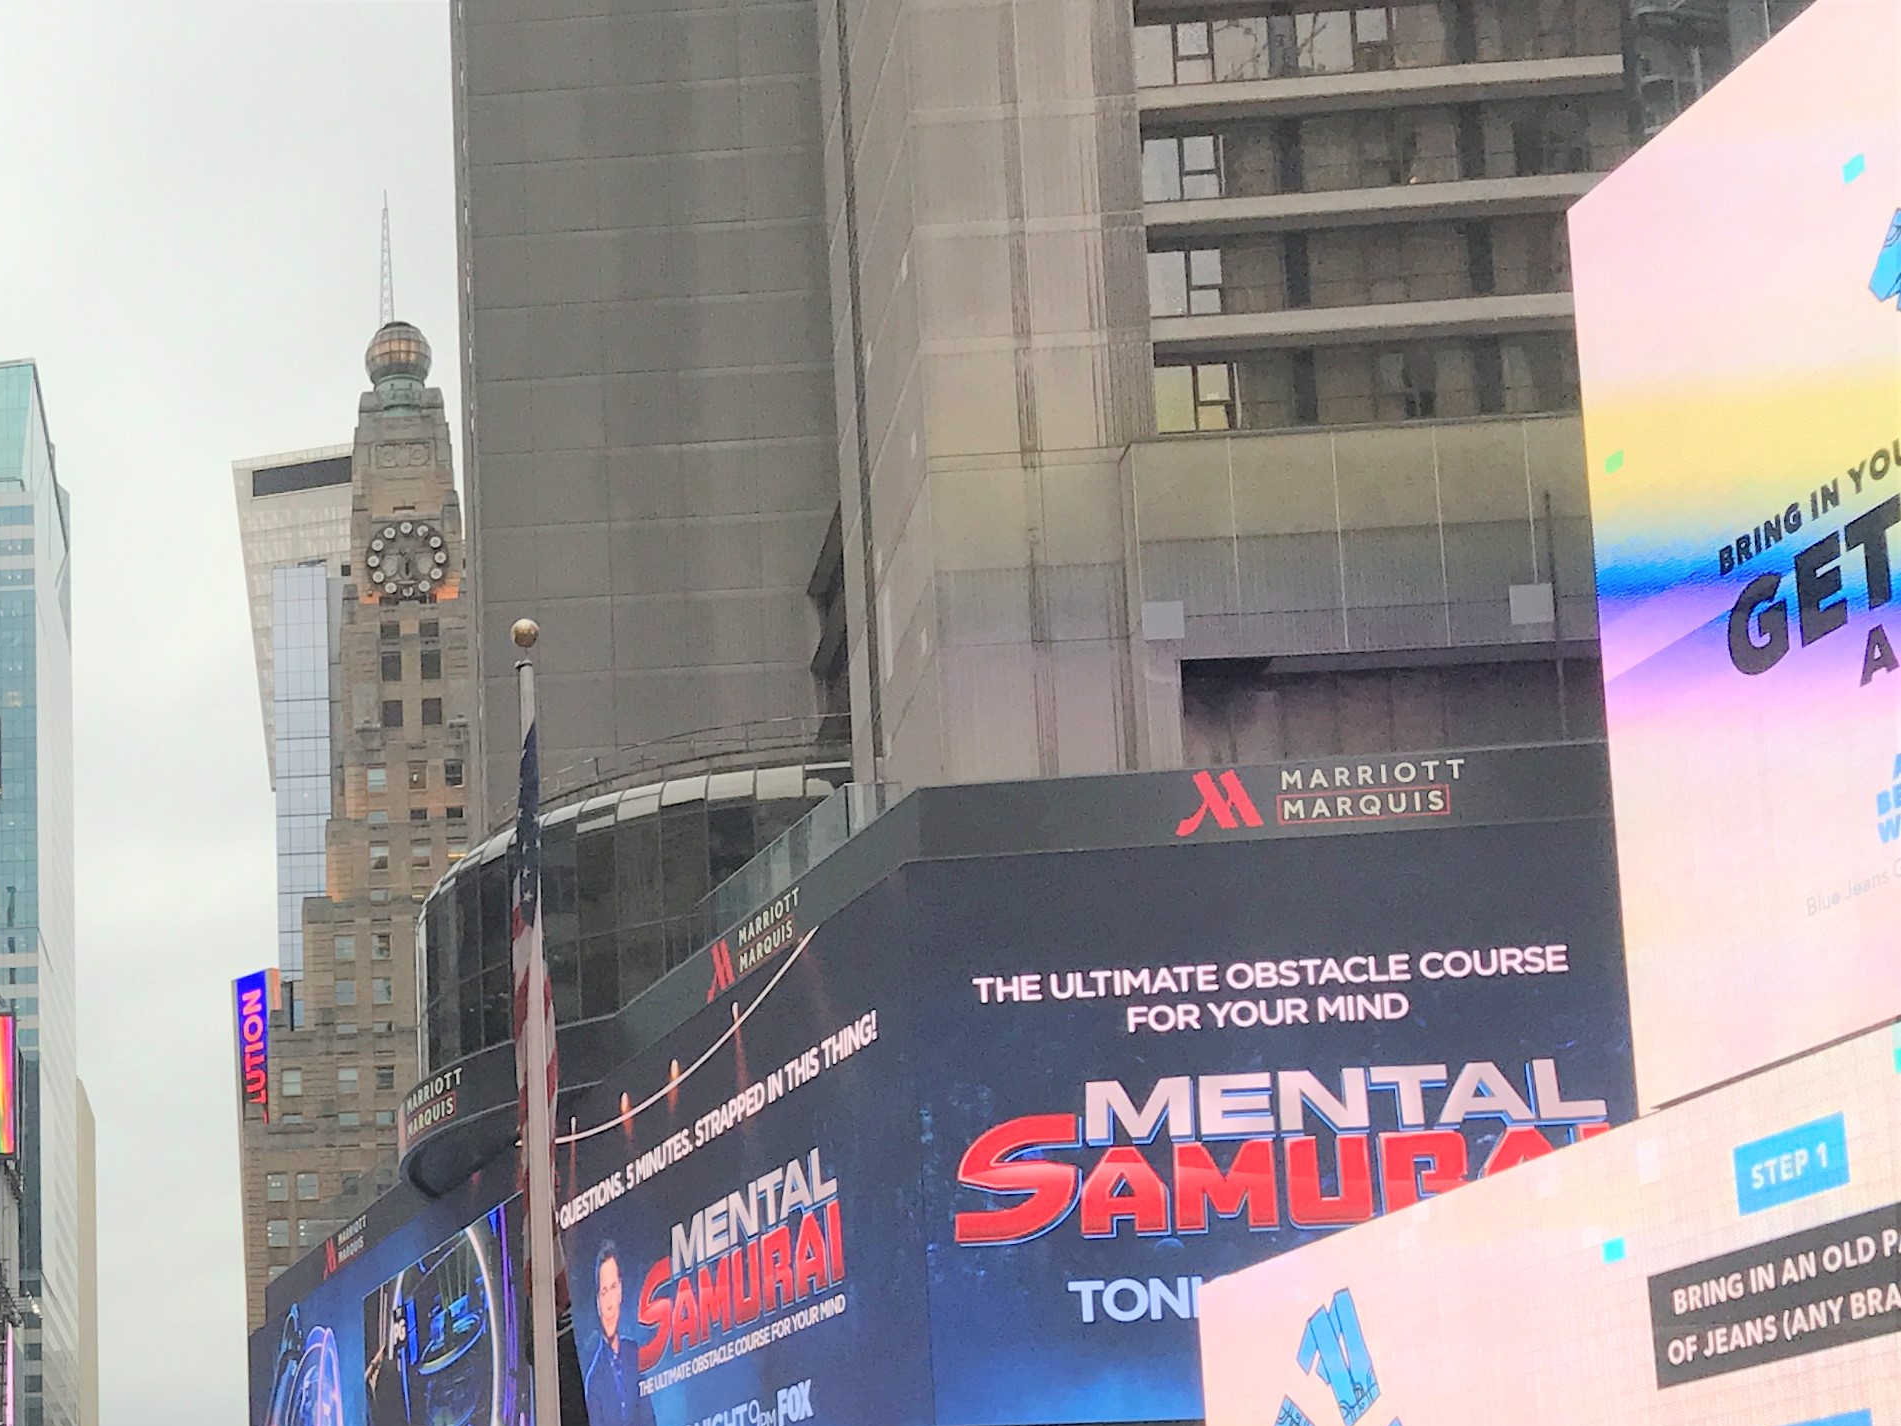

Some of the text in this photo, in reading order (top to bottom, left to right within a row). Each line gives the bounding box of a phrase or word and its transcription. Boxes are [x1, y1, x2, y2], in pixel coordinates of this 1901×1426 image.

[1719, 477, 1841, 576] BRING IN
[1727, 493, 1901, 676] GET
[1281, 759, 1466, 791] MARRIOTT
[1281, 789, 1447, 821] MARQUIS
[738, 886, 800, 947] MARRIOTT
[1806, 870, 1891, 917] Blue Jeans
[738, 920, 794, 974] MARQUIS
[972, 944, 1570, 1004] THE ULTIMATE OBSTACLE COURSE
[1126, 993, 1410, 1034] FOR YOUR MIND
[405, 1065, 463, 1116] MARRIOTT
[405, 1093, 456, 1139] MARQUIS
[559, 1008, 879, 1230] QUESTIONS. 5 MINUTES. STRAPPED IN THIS THING!
[1085, 1057, 1608, 1145] MENTAL
[1751, 1142, 1828, 1190] STEP 1
[671, 1147, 838, 1276] MENTAL
[638, 1200, 846, 1374] SAMURAI
[1672, 1236, 1876, 1316] BRING IN AN OLD
[638, 1293, 846, 1397] THE ULTIMATE OBSTACLE COURSE FOR YOUR MIND
[1667, 1336, 1698, 1367] OF
[1703, 1314, 1778, 1358] JEANS
[1783, 1297, 1843, 1341] (ANY
